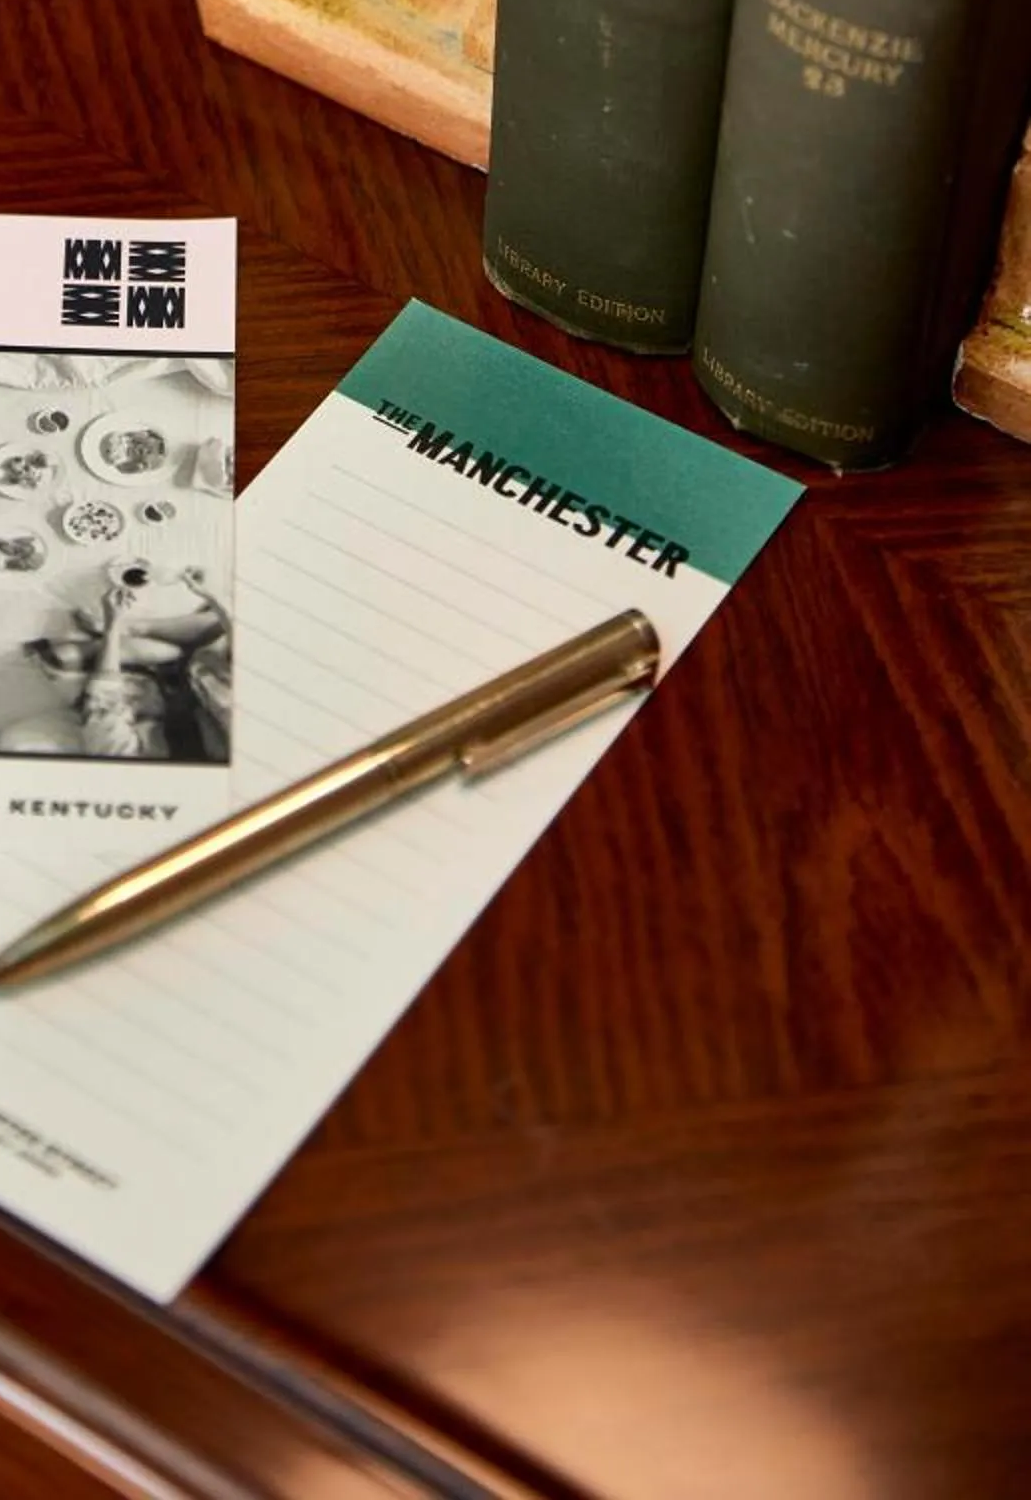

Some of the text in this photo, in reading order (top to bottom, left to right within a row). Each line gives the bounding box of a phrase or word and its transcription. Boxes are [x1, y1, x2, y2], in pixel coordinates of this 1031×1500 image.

[768, 11, 904, 87] MERCURY
[497, 236, 665, 325] LIBRARY EDITION
[702, 347, 875, 443] LIBRARY EDITION
[375, 399, 690, 579] THE MANCHESTER
[9, 799, 180, 822] KENTUCKY
